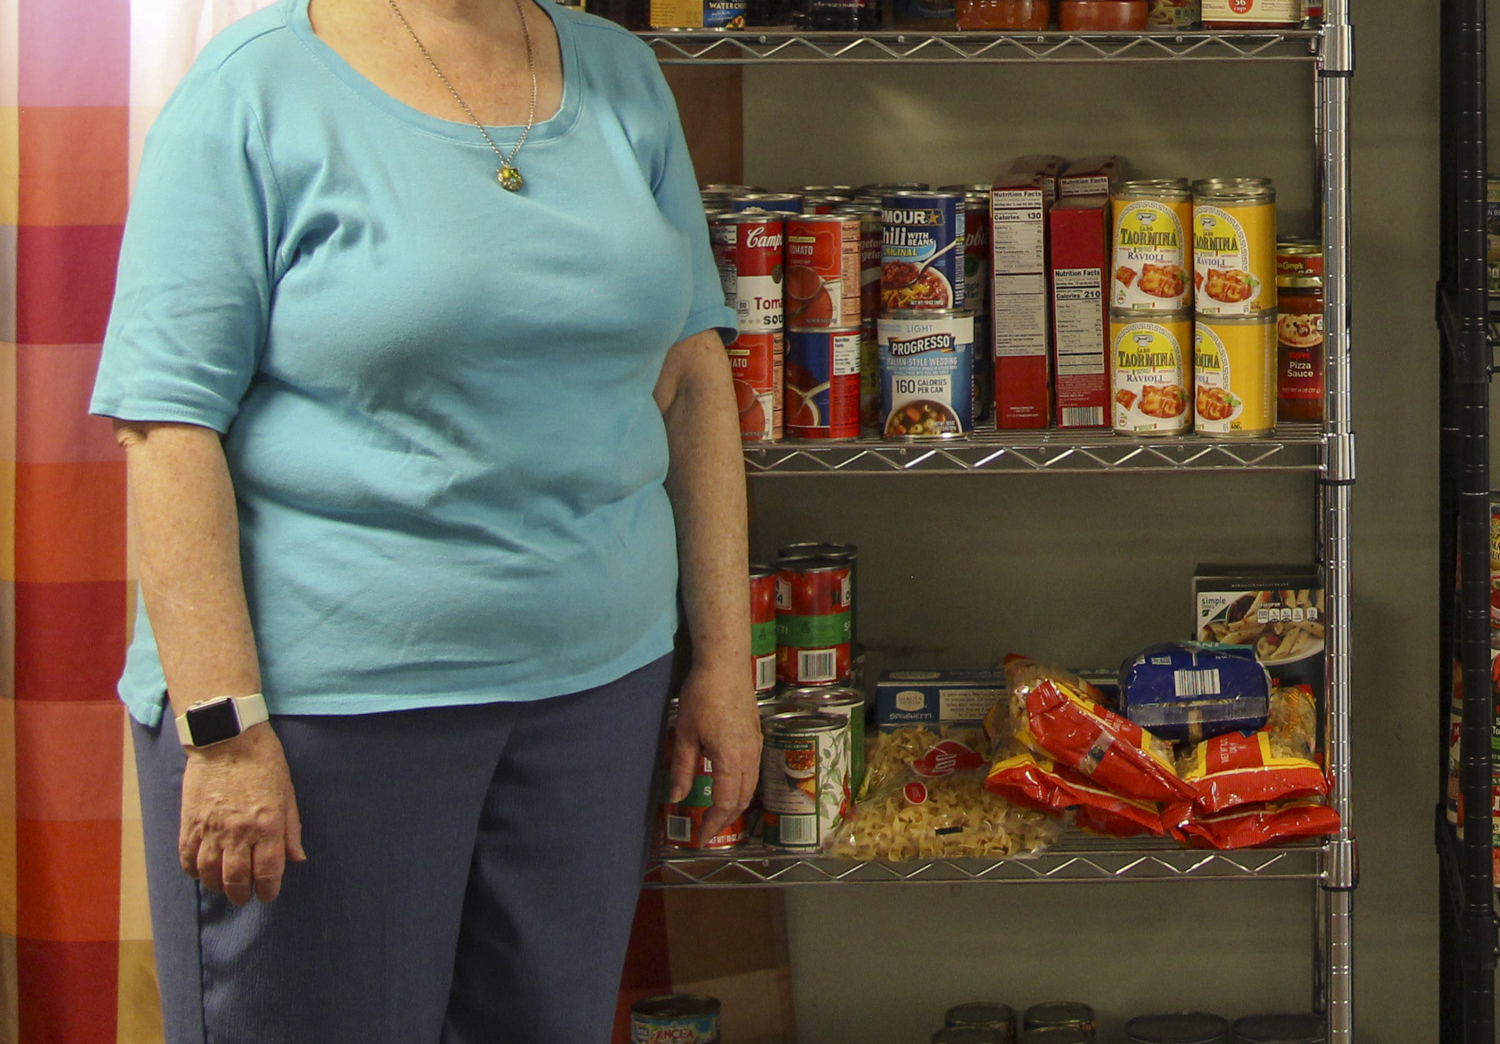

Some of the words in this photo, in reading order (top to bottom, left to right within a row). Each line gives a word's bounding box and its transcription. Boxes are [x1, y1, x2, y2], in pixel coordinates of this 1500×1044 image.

[1027, 212, 1041, 220] 130
[908, 238, 934, 246] BEANS
[1128, 252, 1163, 262] RAVIOLI
[907, 325, 933, 333] LIGHT
[892, 335, 951, 355] PROGRESSO
[1289, 362, 1311, 371] Pizza
[1287, 370, 1313, 378] Sauce
[896, 380, 915, 393] 160
[1202, 597, 1226, 607] simple
